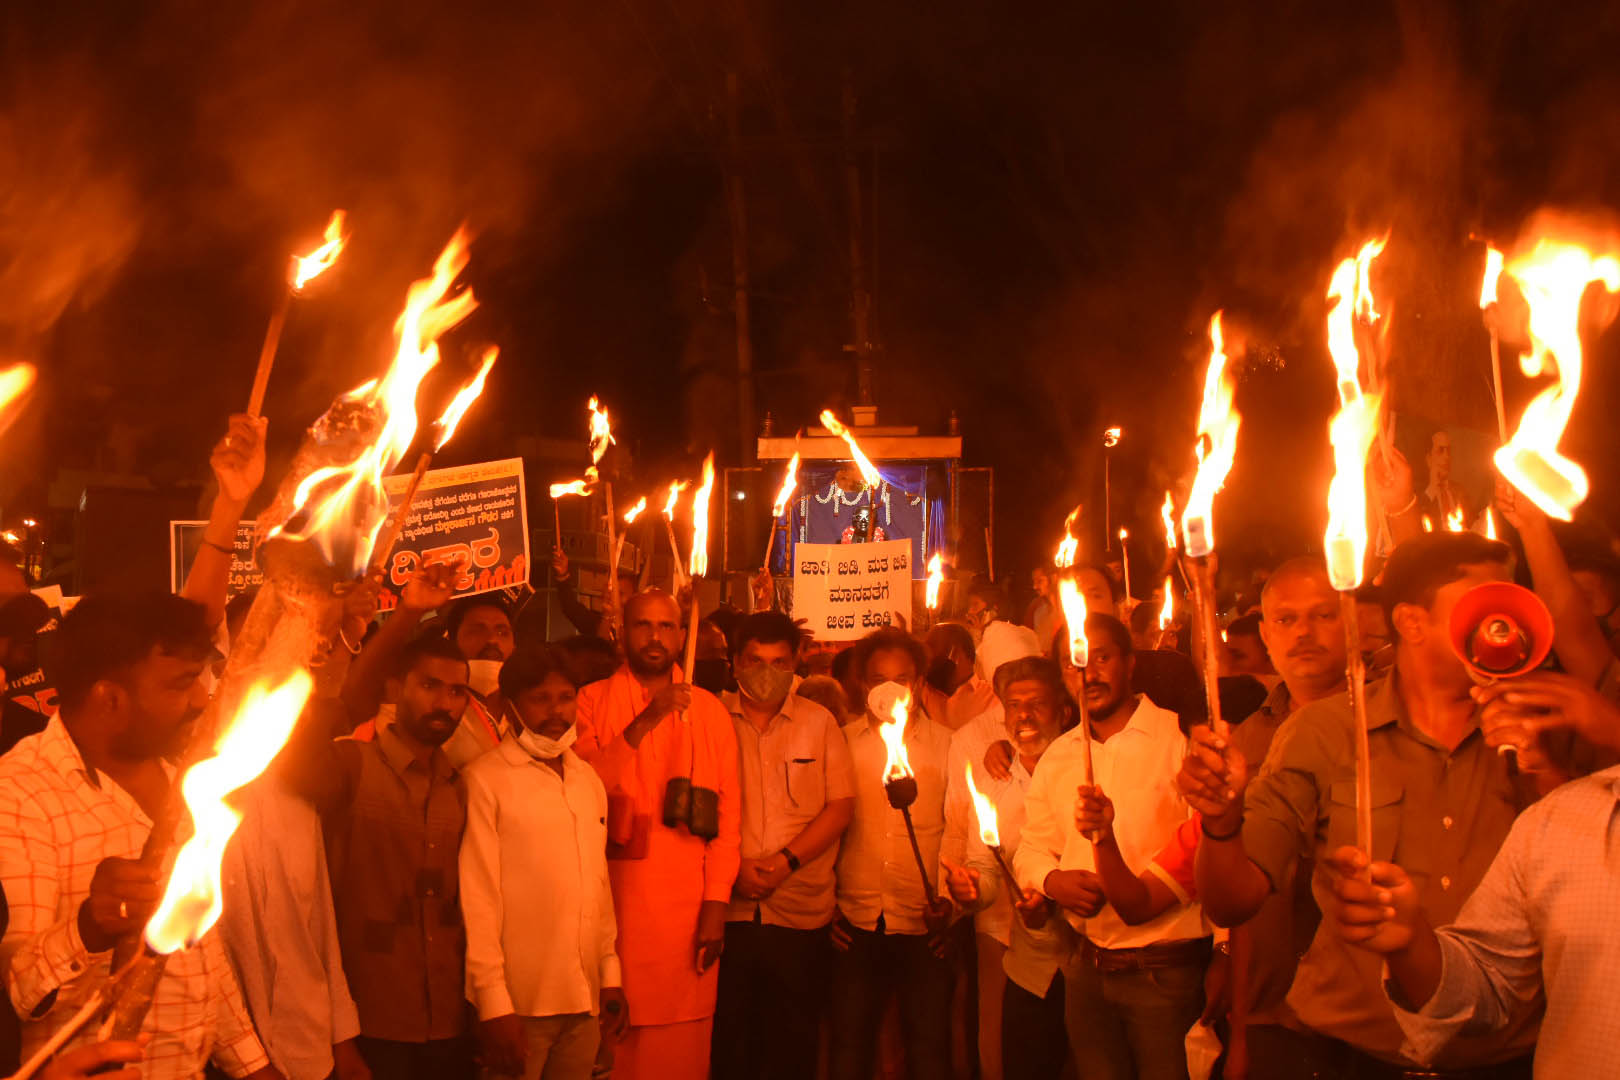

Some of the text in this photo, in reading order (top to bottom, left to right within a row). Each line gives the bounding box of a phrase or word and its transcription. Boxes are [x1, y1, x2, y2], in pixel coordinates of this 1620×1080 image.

[801, 559, 830, 576] ಜಾತಿ
[868, 555, 889, 574] ಮತ
[829, 580, 890, 603] ಮಾನವತೆಗೆ
[827, 609, 891, 629] ಜೀವ ಕೊಡಿ
